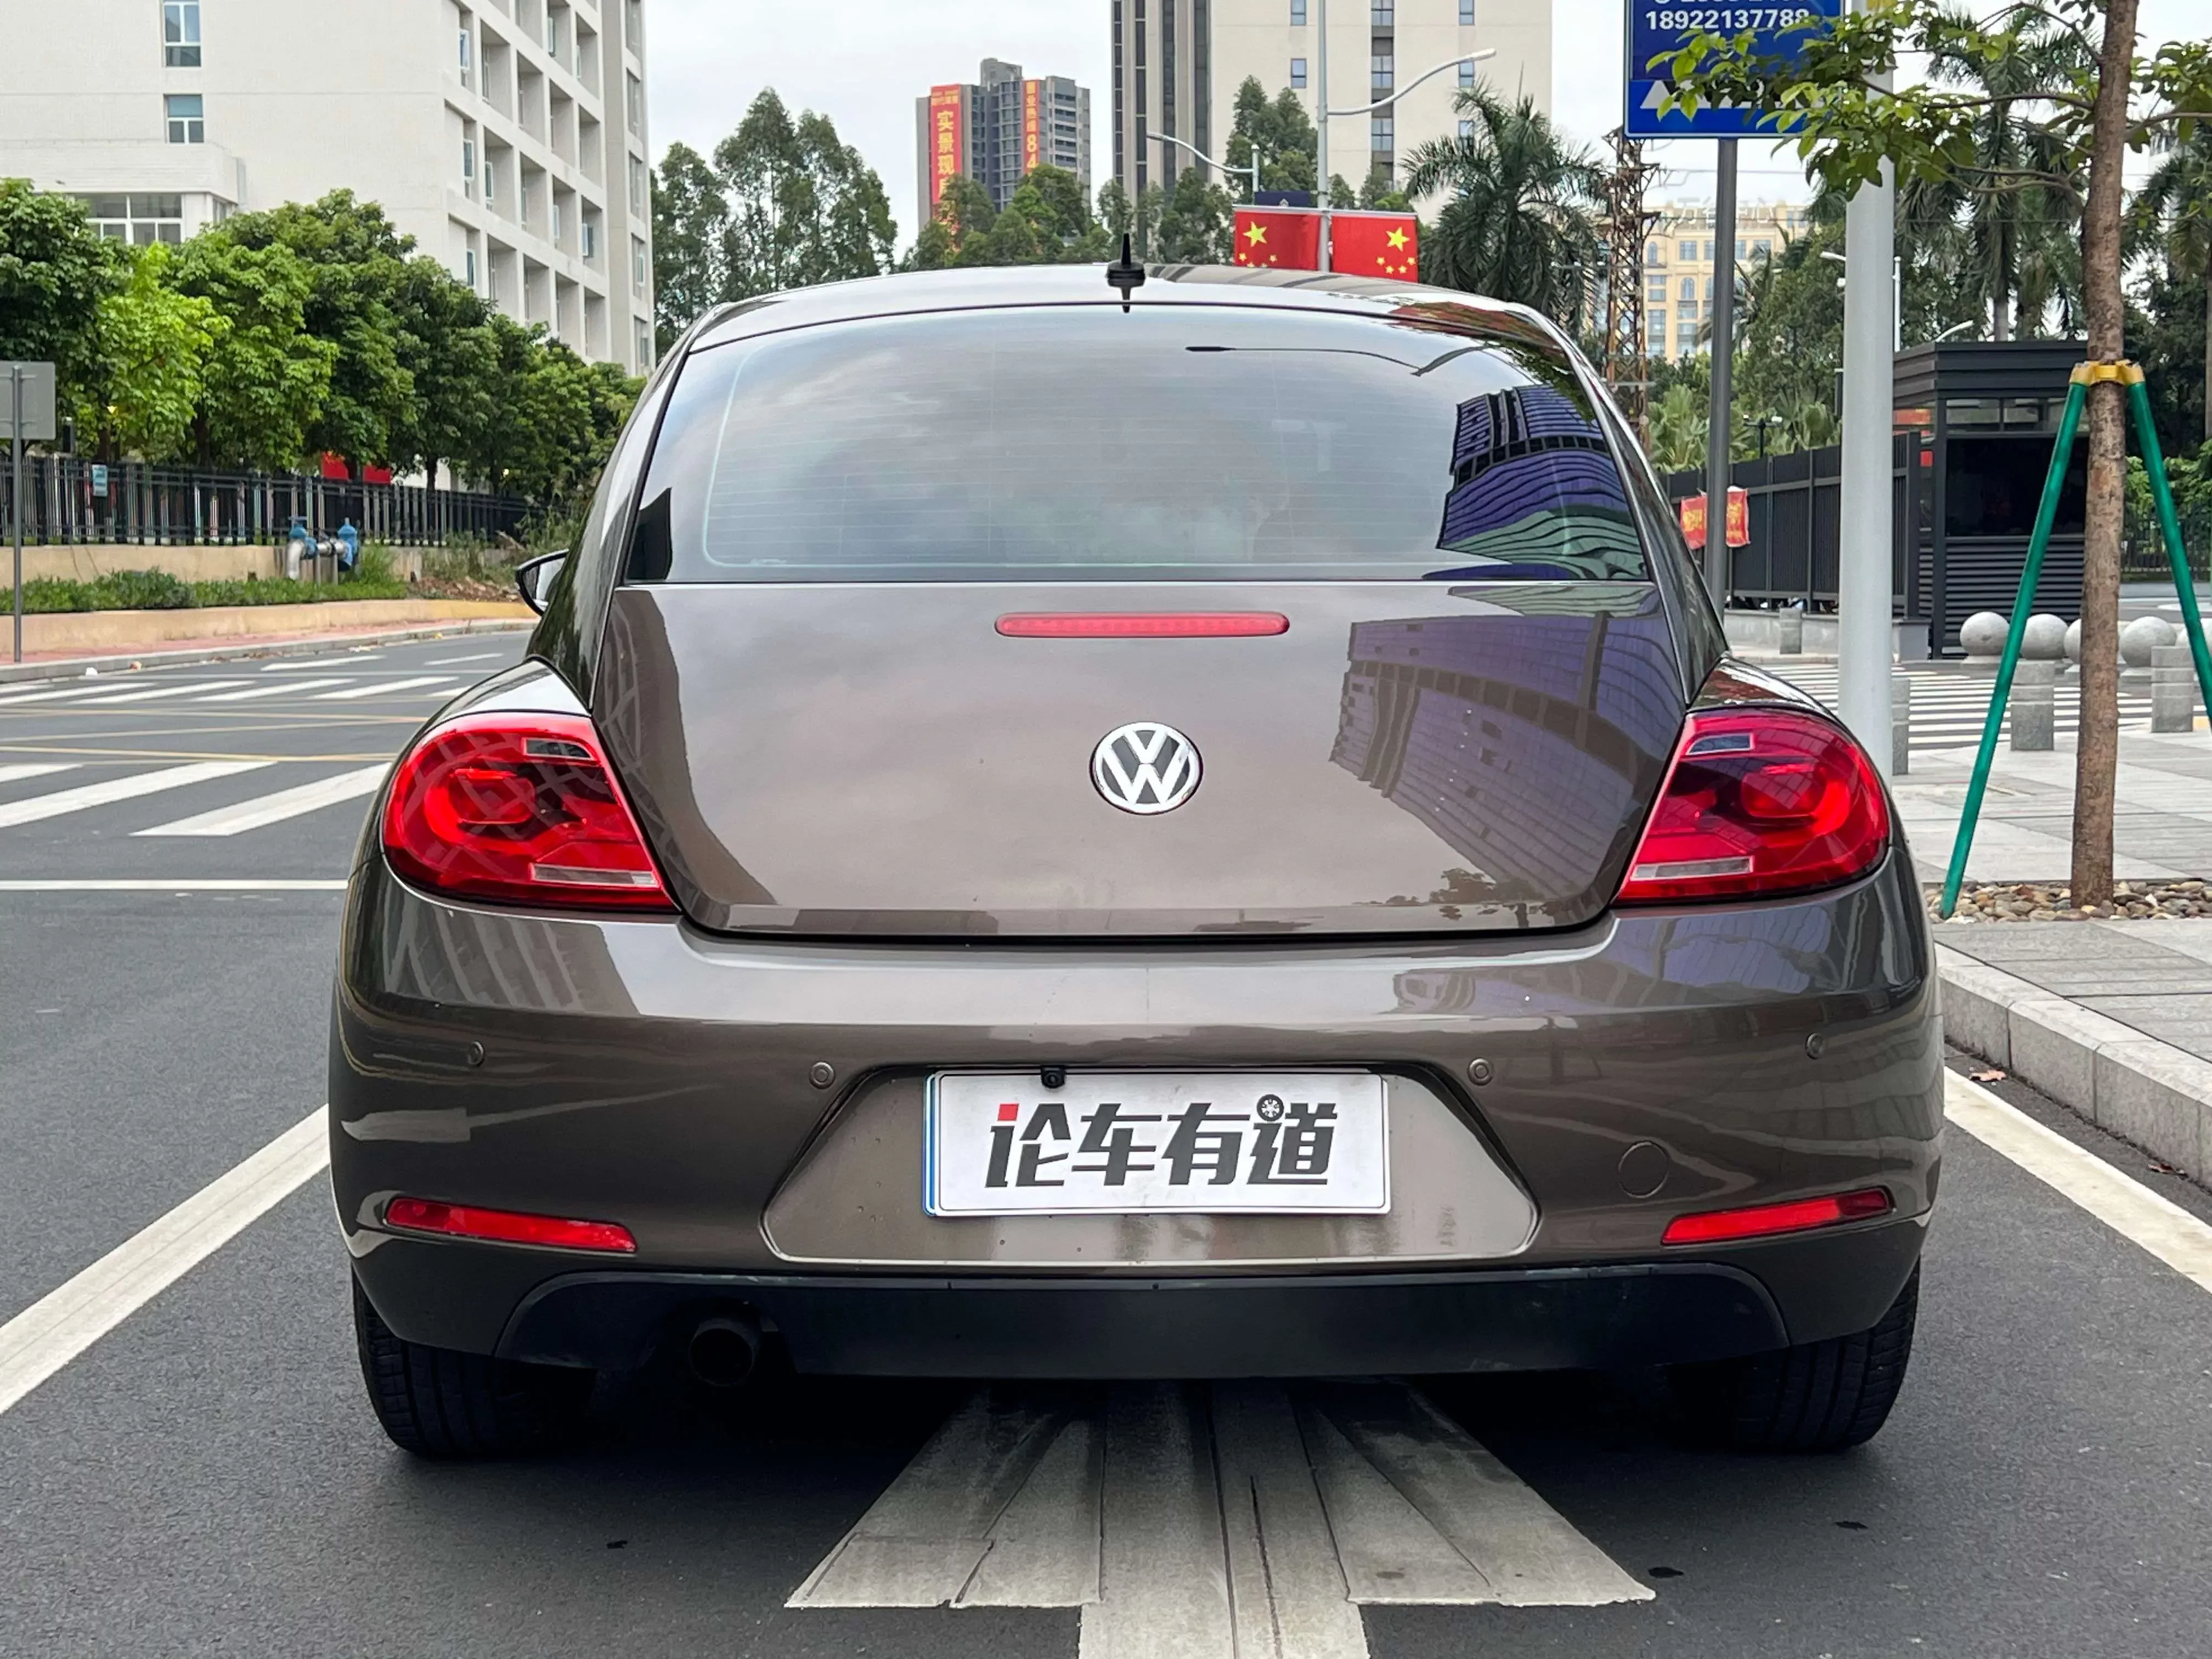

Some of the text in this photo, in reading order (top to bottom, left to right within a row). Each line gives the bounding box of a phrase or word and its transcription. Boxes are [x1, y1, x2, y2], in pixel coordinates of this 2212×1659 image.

[1646, 9, 1809, 30] 18922137788
[985, 1093, 1338, 1188] 论车有道
